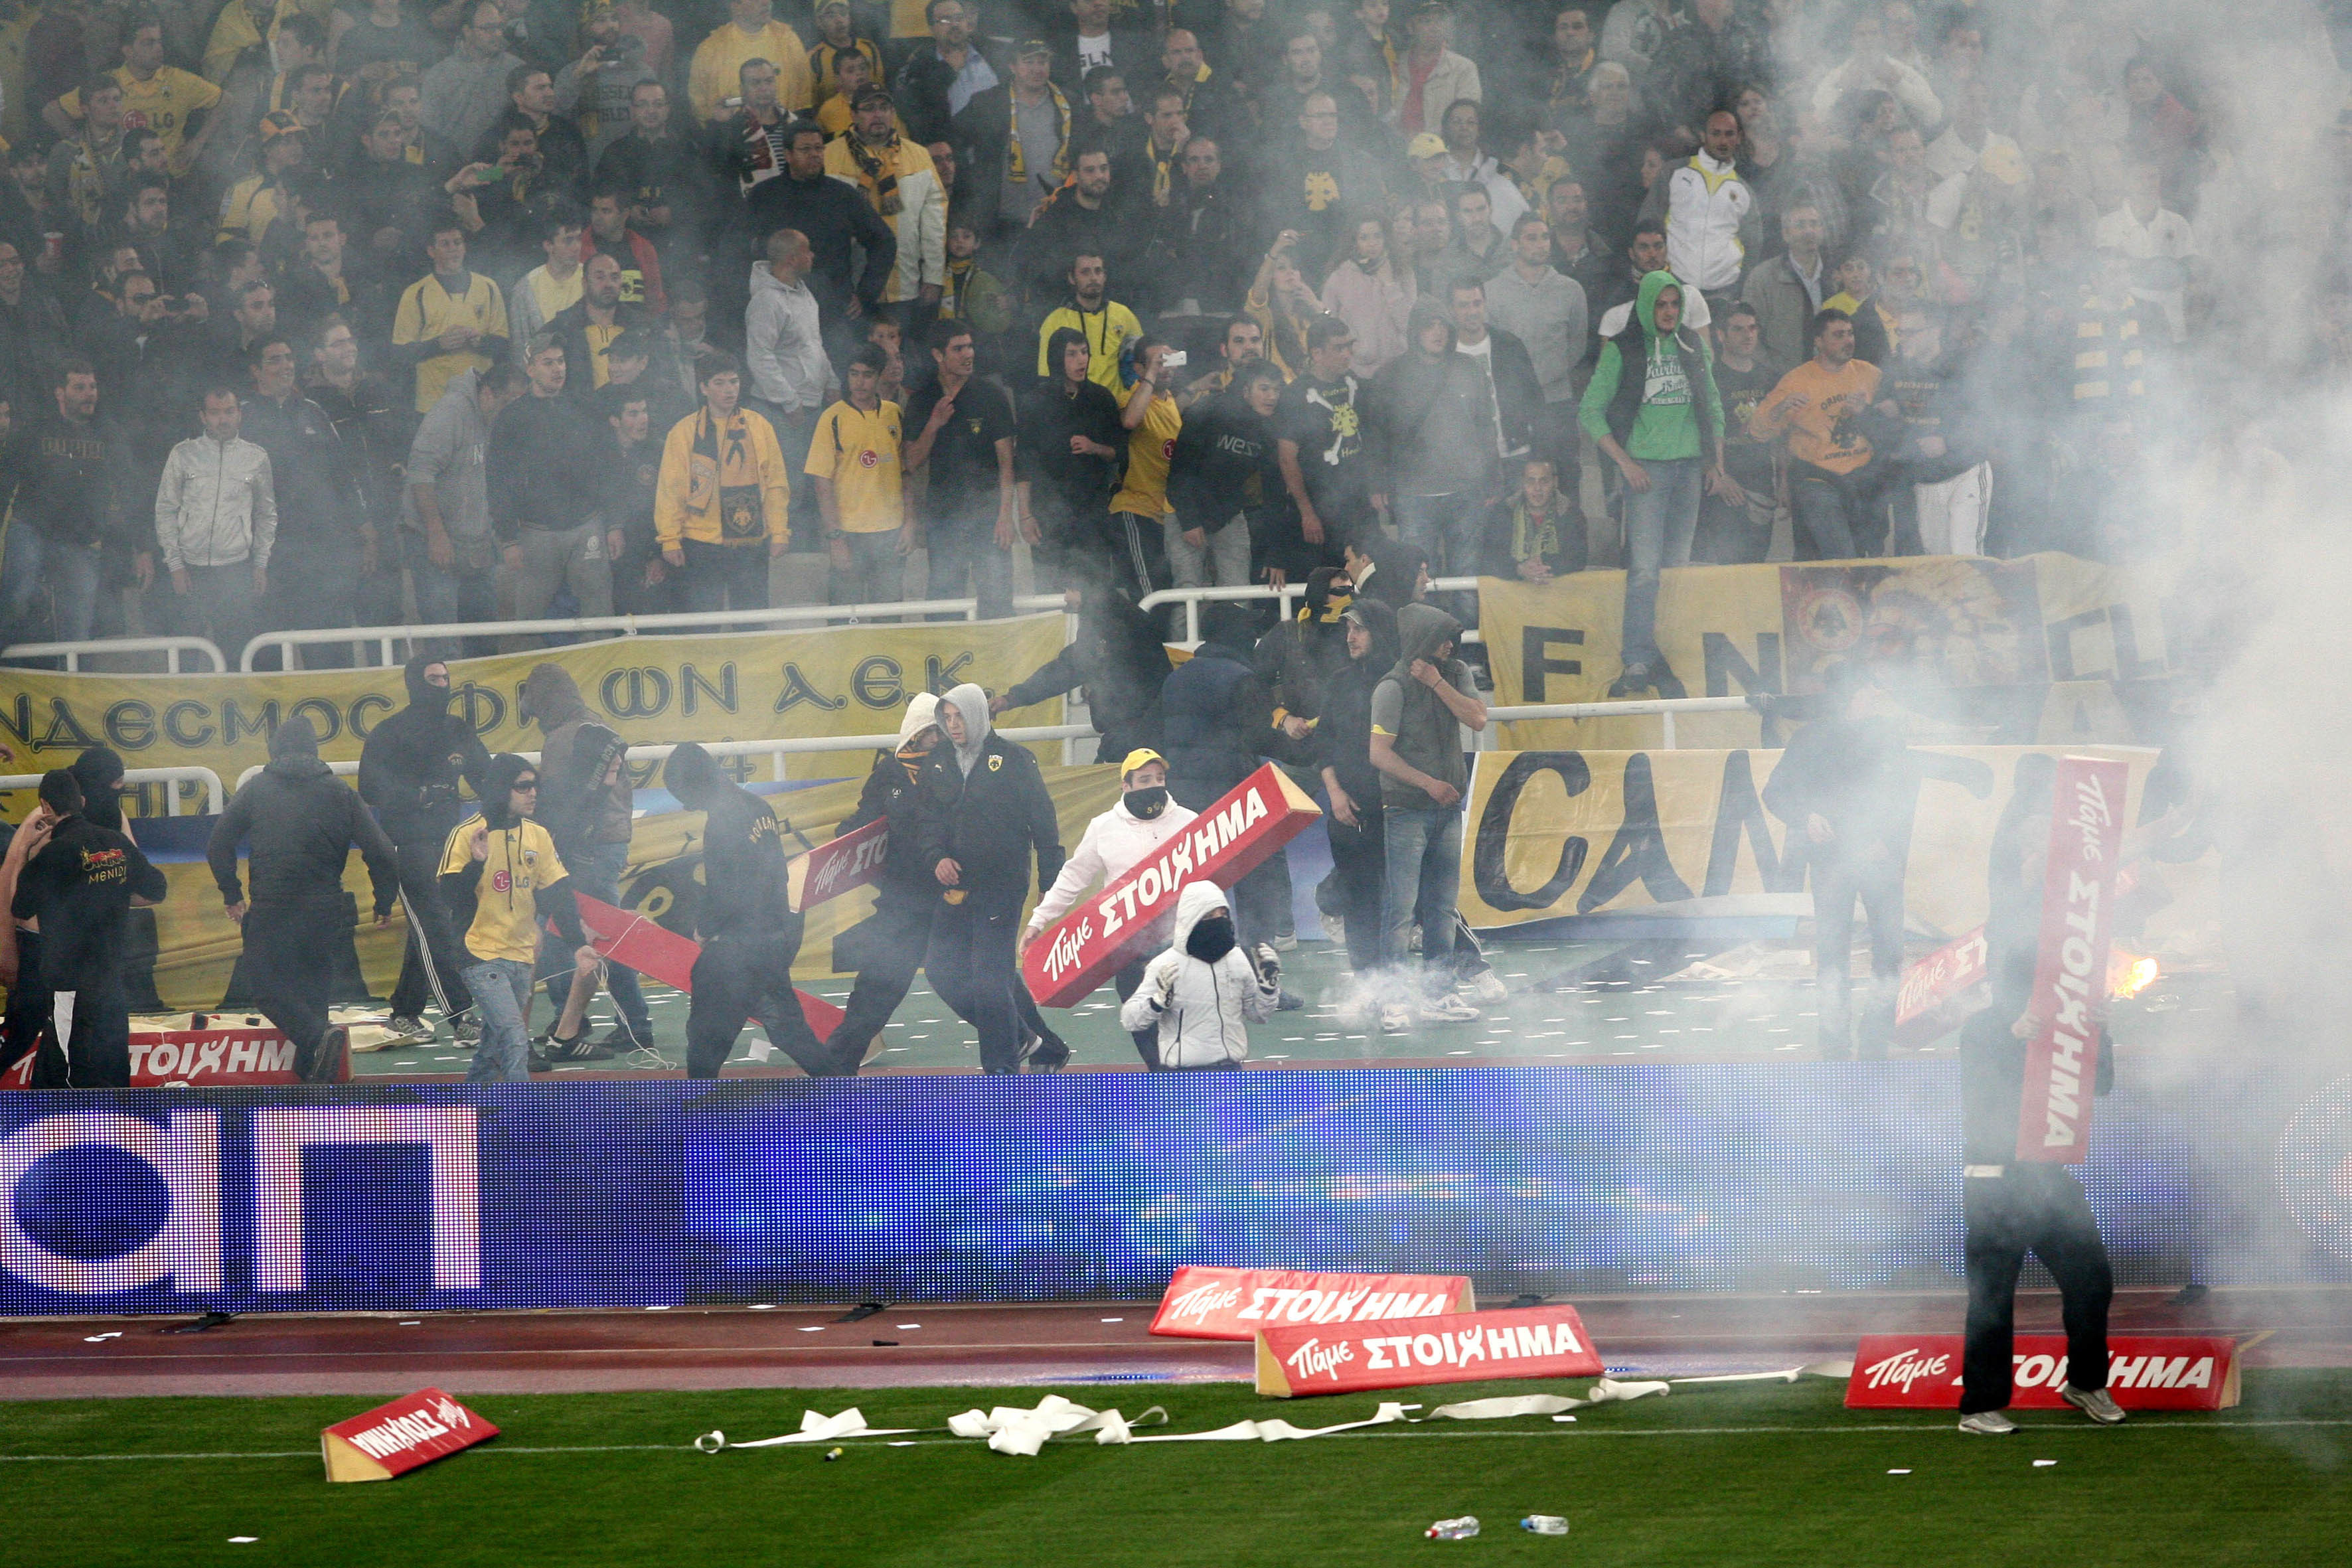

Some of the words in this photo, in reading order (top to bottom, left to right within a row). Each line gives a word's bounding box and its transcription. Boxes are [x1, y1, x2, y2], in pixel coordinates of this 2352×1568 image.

[2067, 773, 2112, 862] Πάμε
[849, 830, 890, 877] ΣΤΟ
[1043, 917, 1093, 982] Πάμε
[1099, 787, 1269, 939] ΣΤΟΙΧΗΜΑ
[1954, 937, 1988, 980] ΣΤ
[2043, 870, 2100, 1147] ΣΤΟΙΧΗΜΑ
[1170, 1281, 1243, 1326] Πάμε
[1237, 1286, 1449, 1322] ΣΤΟΙΧΗΜΑ
[1287, 1338, 1356, 1381] Πάμε
[1362, 1322, 1584, 1371] ΣΤΟΙΧΗΜΑ
[1864, 1349, 1950, 1394] Πάμε
